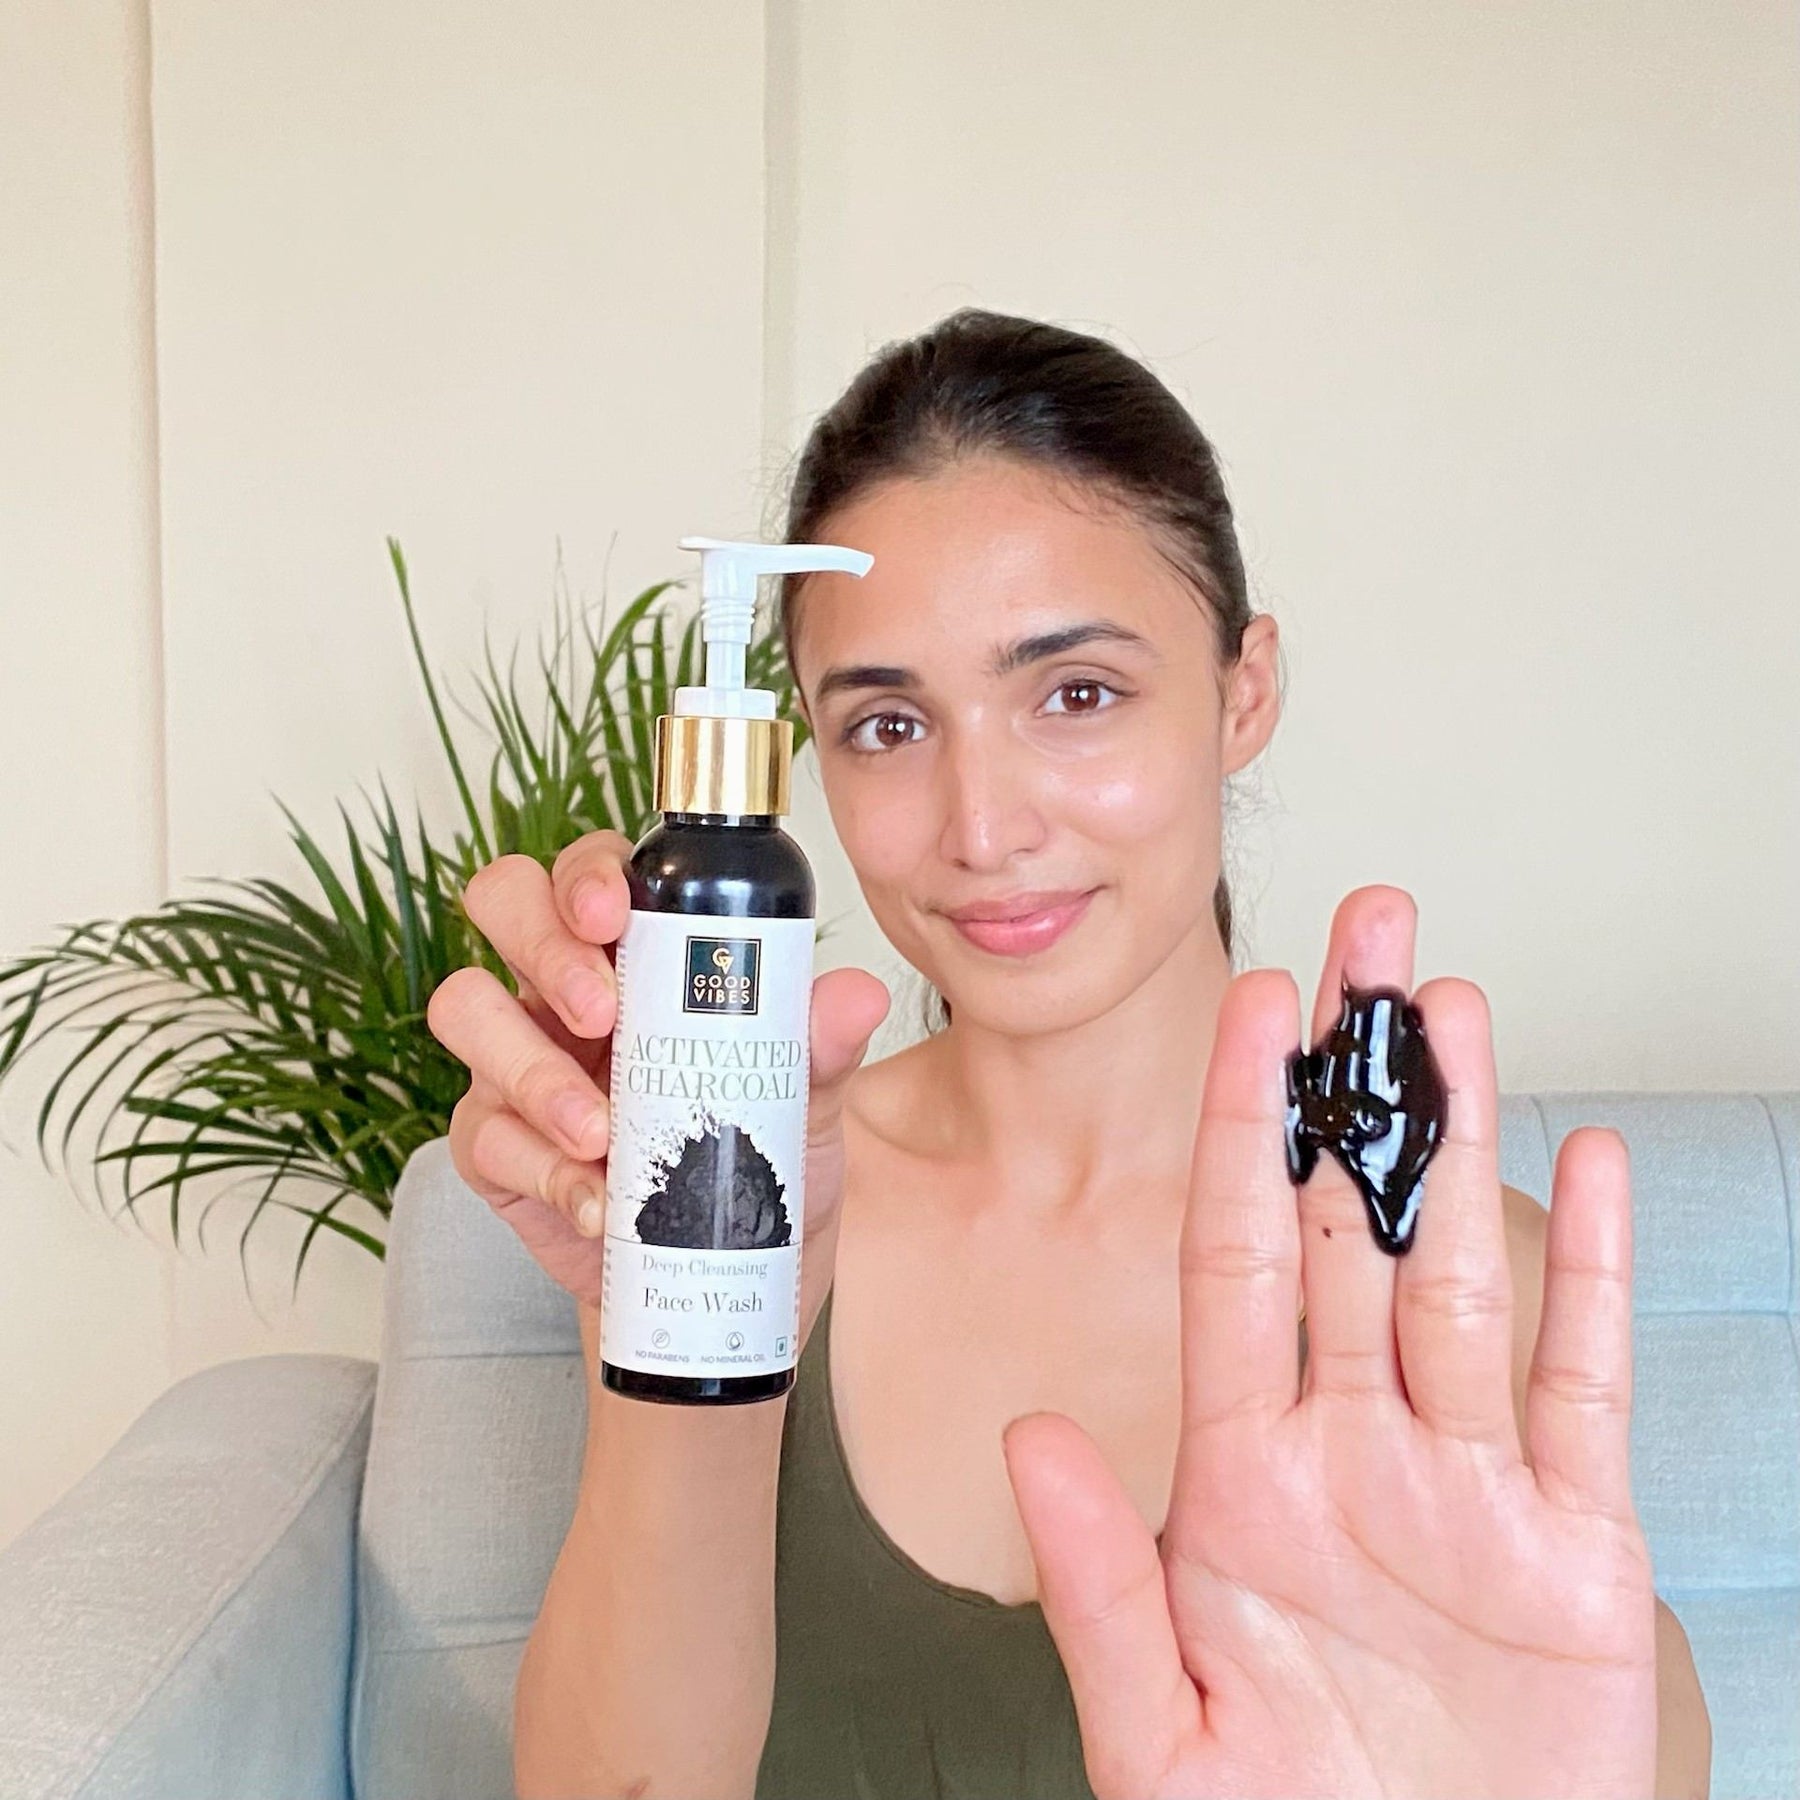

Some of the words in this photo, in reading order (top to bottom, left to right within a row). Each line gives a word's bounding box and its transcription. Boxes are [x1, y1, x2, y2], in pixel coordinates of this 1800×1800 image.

[693, 974, 751, 989] GOOD
[693, 988, 750, 1004] VIBES
[629, 1033, 801, 1068] ACTIVATED
[628, 1064, 797, 1101] CHARCOAL
[642, 1254, 683, 1278] Deep
[689, 1258, 768, 1279] Cleansing
[642, 1286, 693, 1313] Face
[702, 1291, 763, 1314] Wash
[635, 1349, 647, 1359] NO
[700, 1355, 715, 1363] NO
